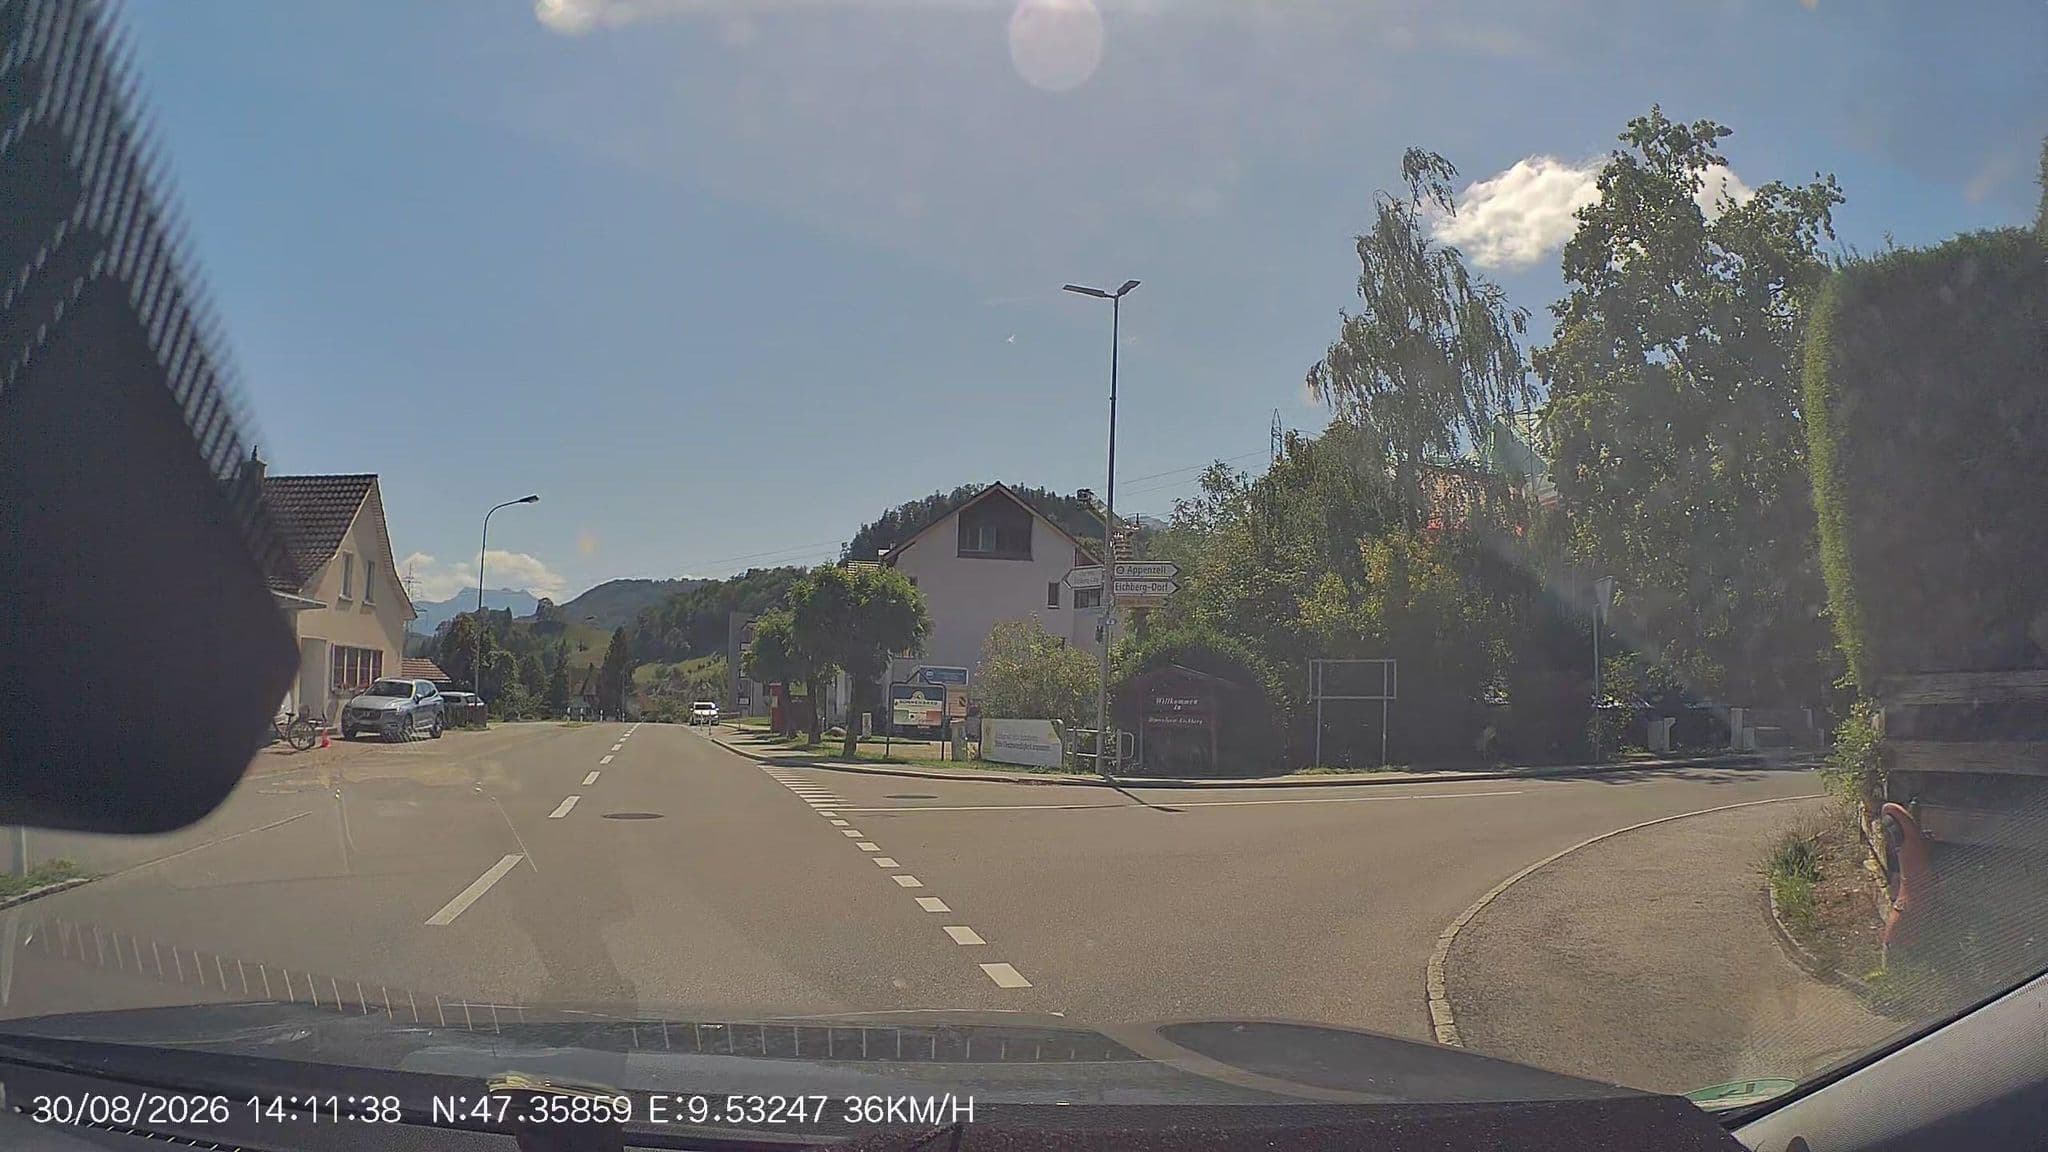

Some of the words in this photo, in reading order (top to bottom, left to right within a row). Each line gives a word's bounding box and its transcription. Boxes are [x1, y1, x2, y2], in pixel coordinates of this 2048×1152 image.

[1127, 565, 1167, 577] Appenzell
[1115, 582, 1168, 593] Eichberg-Dorf
[1156, 697, 1199, 705] Willkommen
